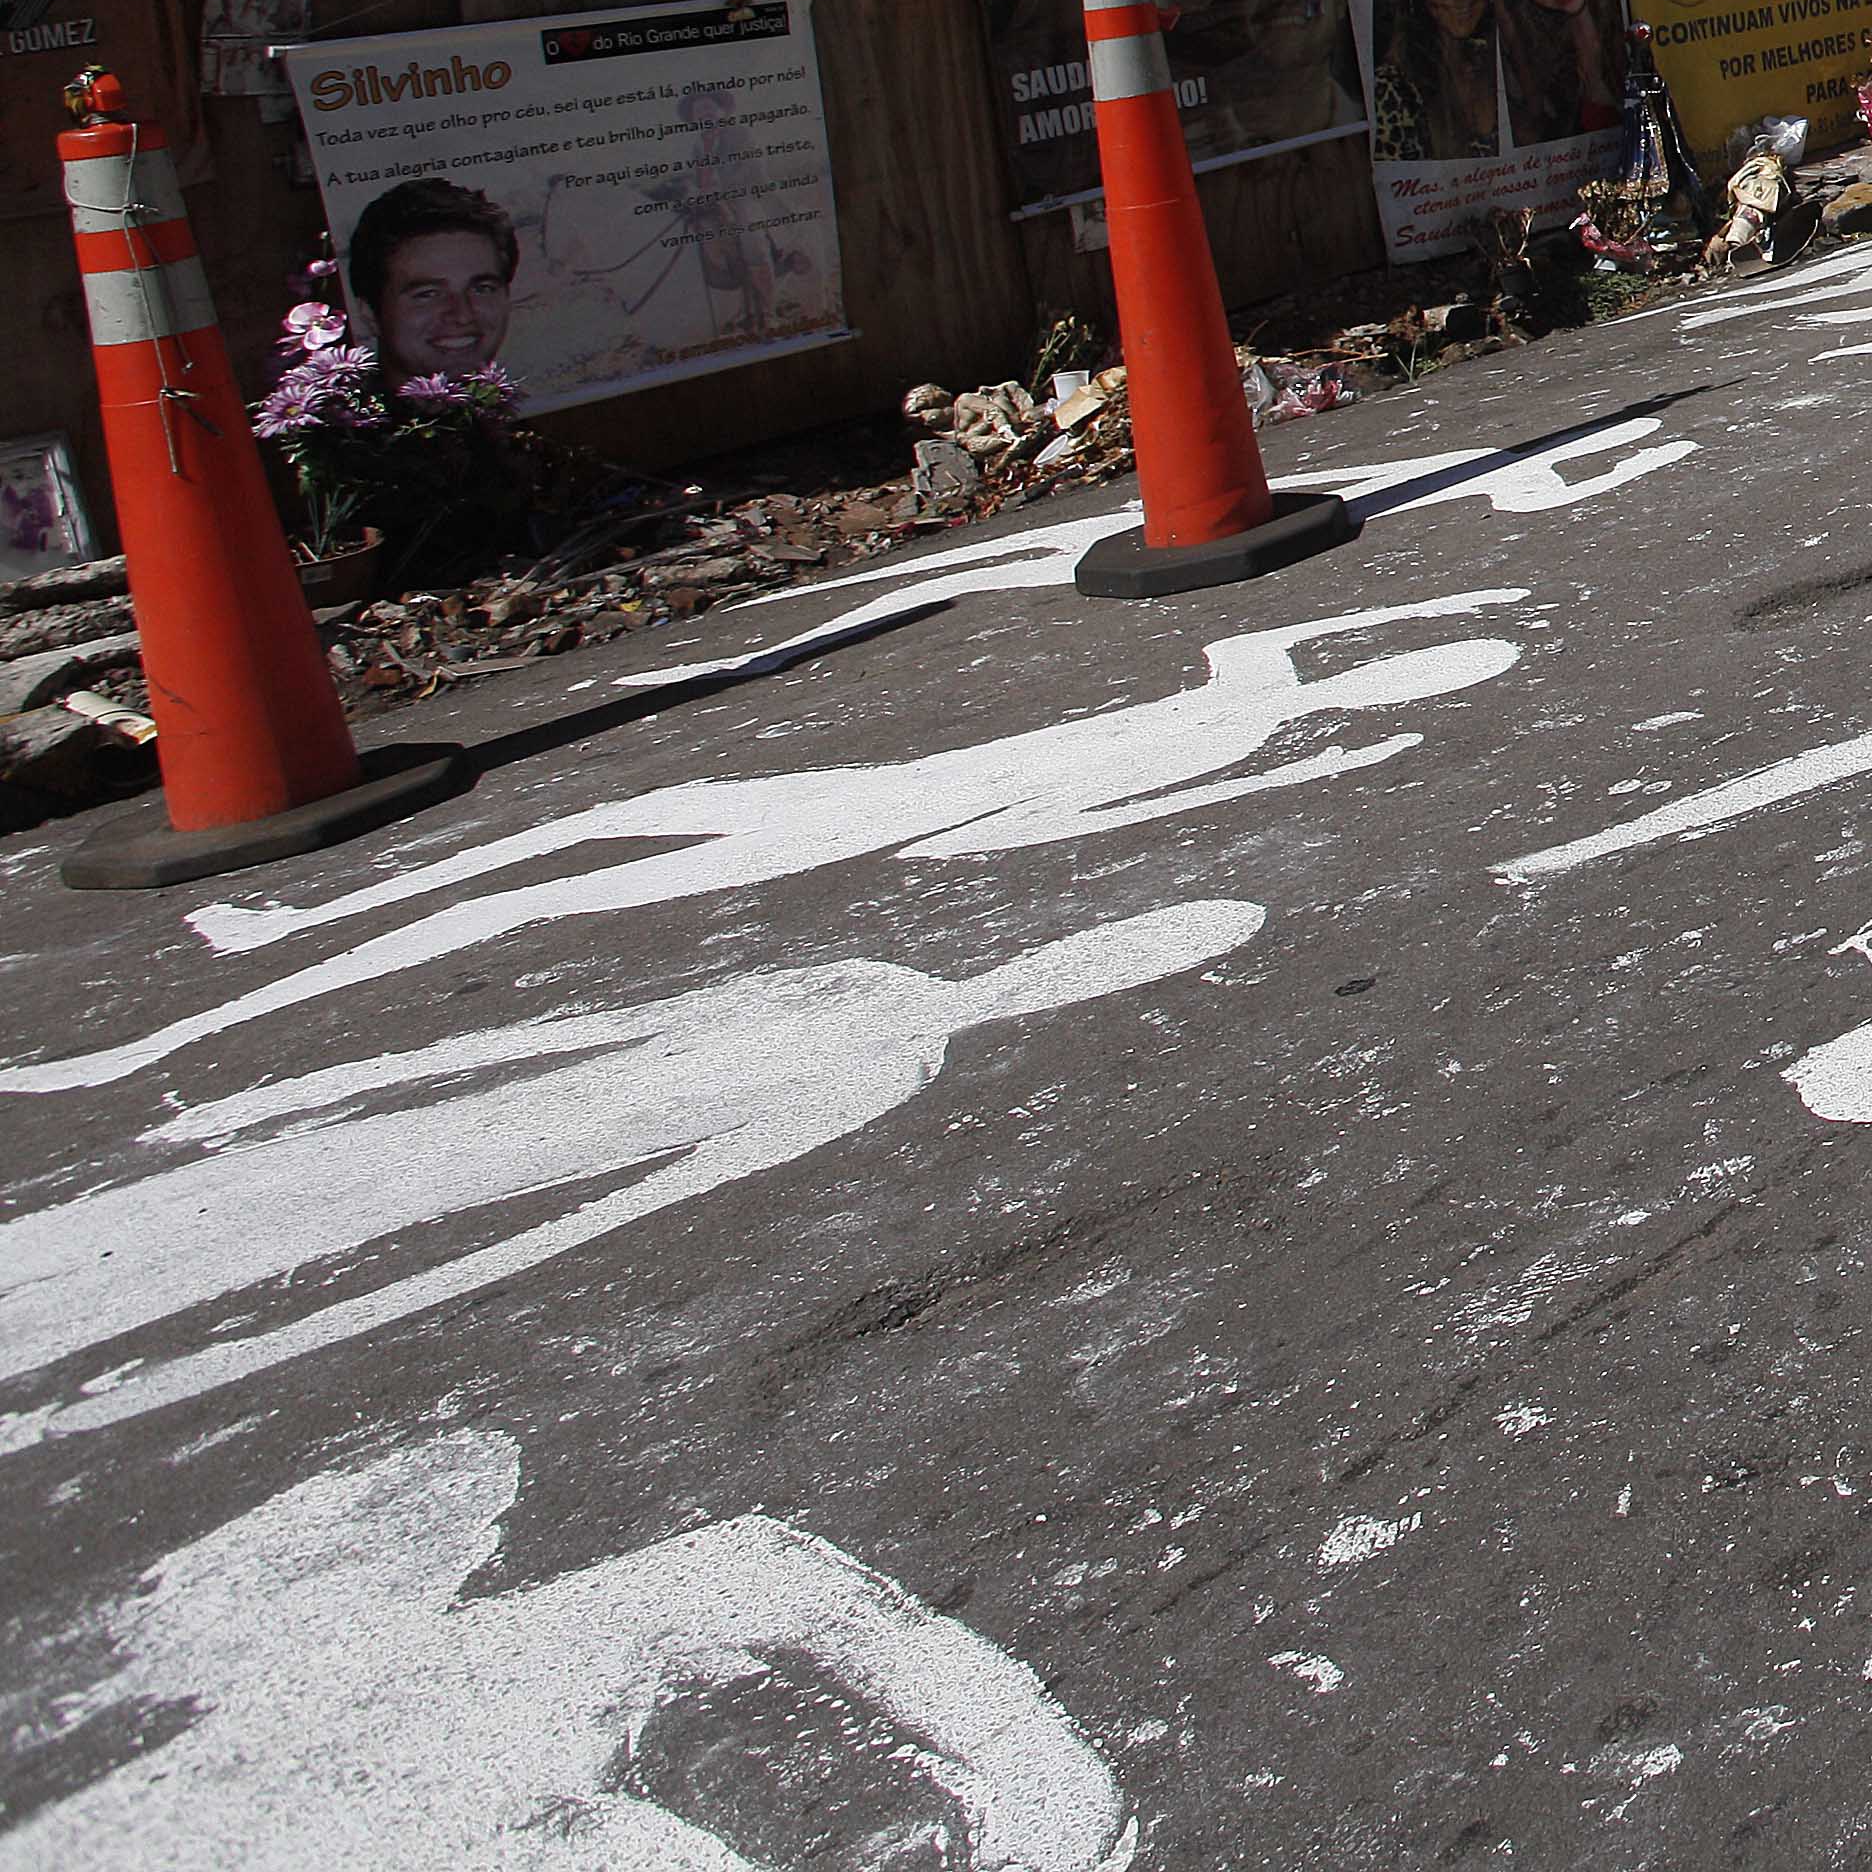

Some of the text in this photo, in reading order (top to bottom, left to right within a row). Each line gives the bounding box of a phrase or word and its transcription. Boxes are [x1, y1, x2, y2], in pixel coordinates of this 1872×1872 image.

[592, 32, 614, 50] do
[616, 31, 644, 49] Rio
[646, 26, 700, 44] Grande
[1656, 5, 1773, 49] CONTINUAM
[1719, 54, 1755, 80] POR
[1761, 33, 1855, 72] MELHORES
[310, 55, 512, 112] Silvinho
[1806, 80, 1847, 105] PARA
[316, 127, 364, 149] Toda
[367, 124, 400, 141] vez
[403, 120, 435, 141] que
[440, 112, 478, 131] olho
[482, 110, 511, 131] pro
[516, 102, 550, 121] céu,
[555, 100, 581, 115] sei
[583, 96, 613, 115] que
[616, 89, 656, 107] está
[682, 79, 746, 99] olhando
[749, 75, 773, 93] por
